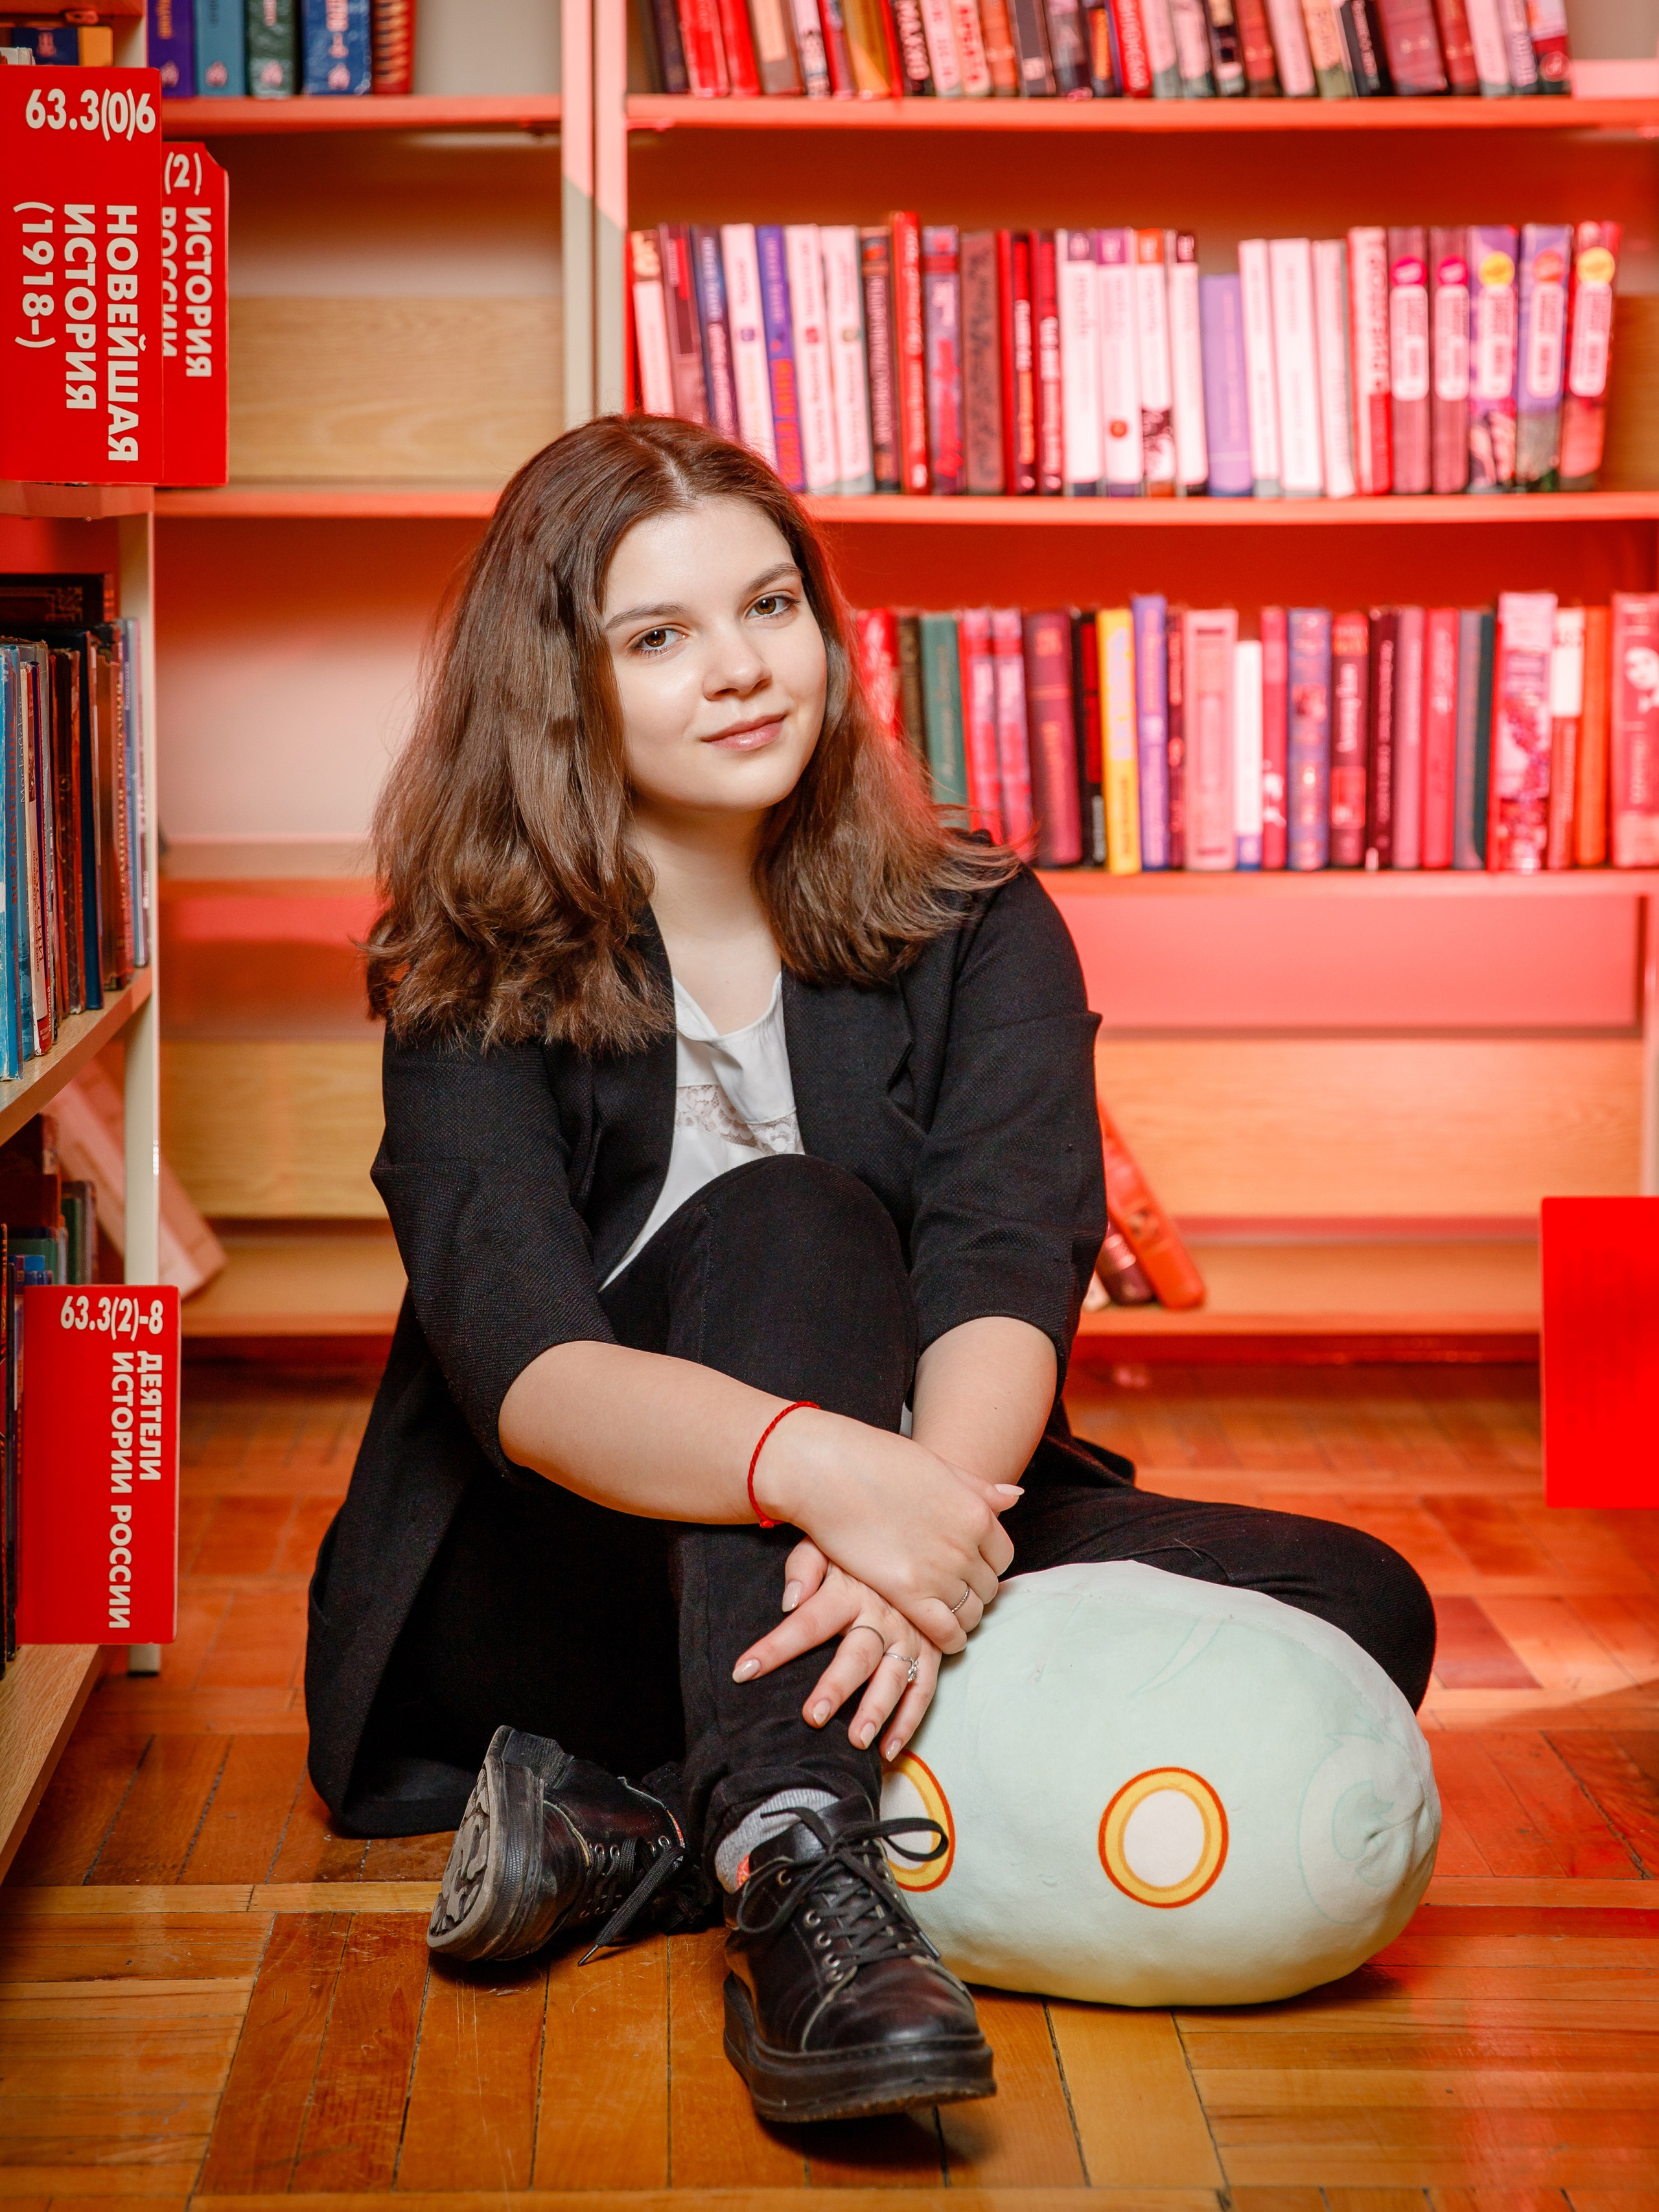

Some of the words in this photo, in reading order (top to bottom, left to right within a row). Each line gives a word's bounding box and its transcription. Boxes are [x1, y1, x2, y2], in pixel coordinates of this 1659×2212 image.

[26, 88, 156, 141] 63.3(0)6
[13, 202, 56, 348] (1918-)
[64, 204, 97, 409] ИСТОРИЯ
[106, 205, 146, 461] НОВЕЙШАЯ
[185, 207, 213, 378] ИСТОРИЯ
[10, 866, 18, 904] ВЕК
[61, 1295, 163, 1342] 63.3(2)-8
[111, 1352, 135, 1493] ИСТОРИИ
[137, 1350, 163, 1480] ДЕЯТЕЛИ
[109, 1505, 133, 1628] РОССИИ
